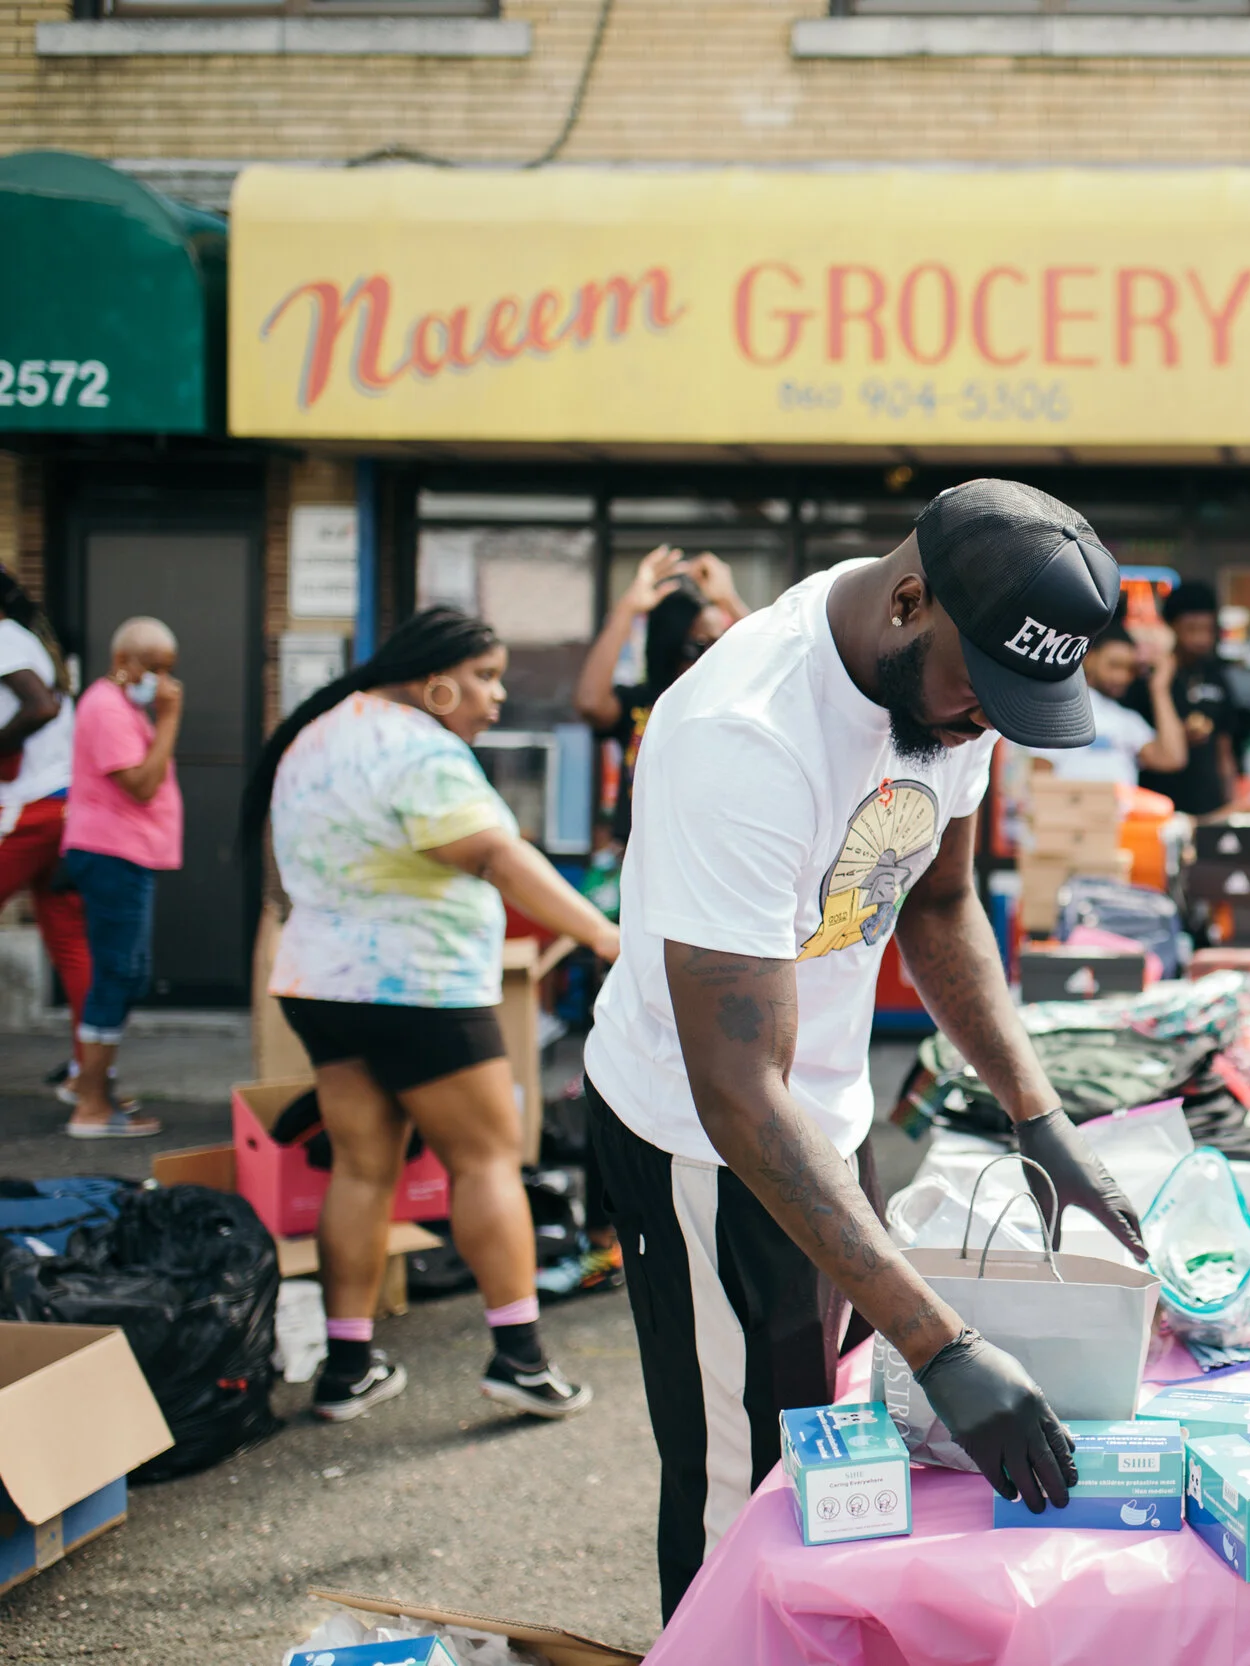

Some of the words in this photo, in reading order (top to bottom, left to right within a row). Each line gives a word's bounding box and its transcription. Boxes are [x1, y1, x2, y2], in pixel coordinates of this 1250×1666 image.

[260, 265, 688, 411] Naeem
[1122, 1457, 1156, 1468] SIHE
[829, 1481, 849, 1489] Caring
[850, 1477, 884, 1487] Everywhere
